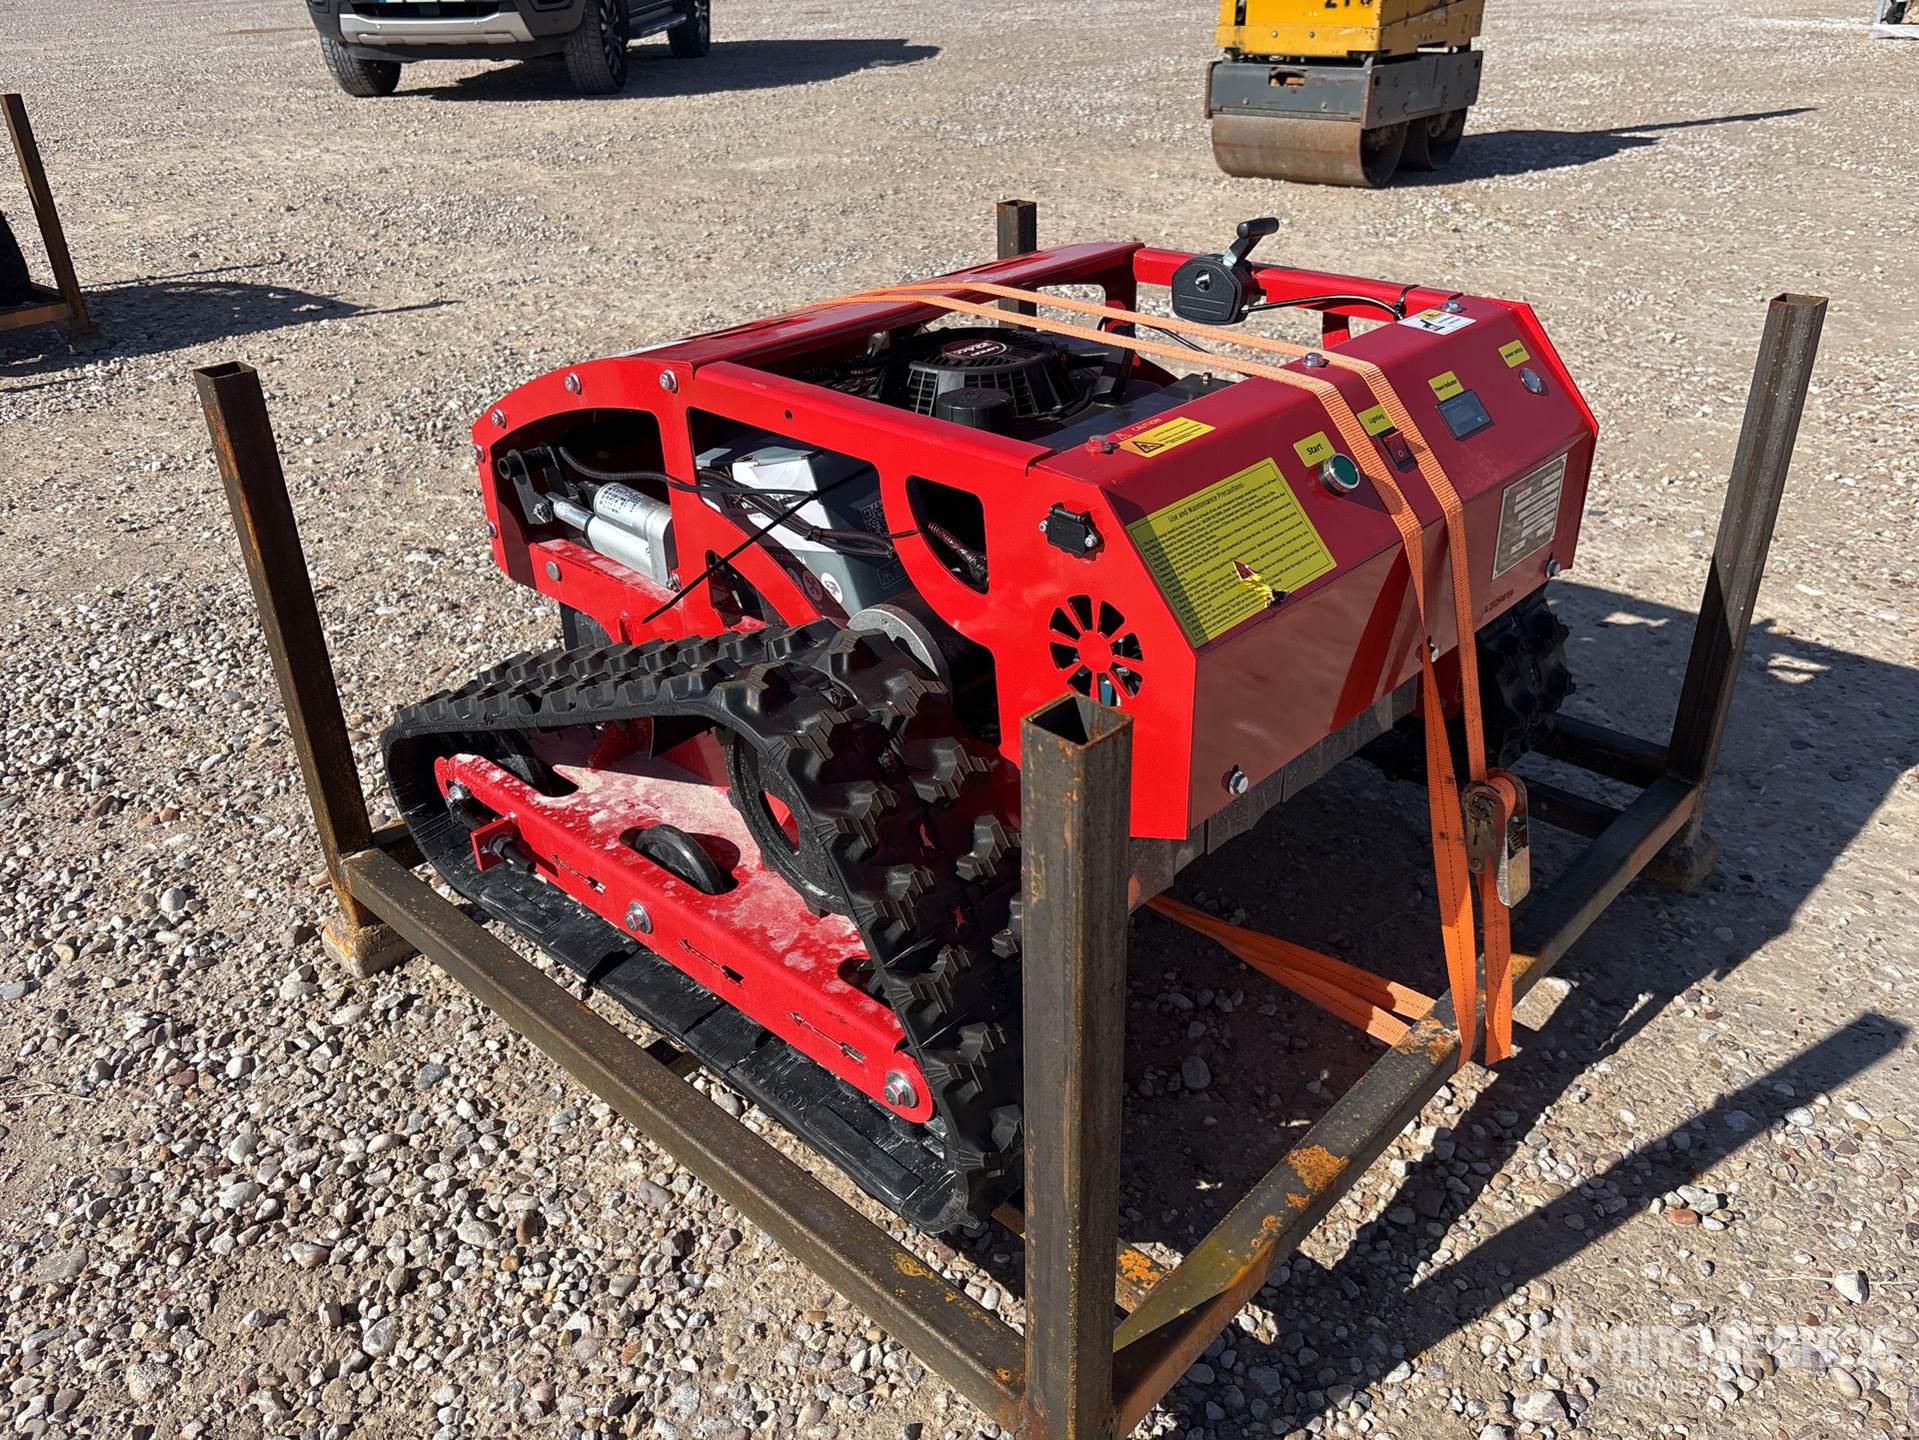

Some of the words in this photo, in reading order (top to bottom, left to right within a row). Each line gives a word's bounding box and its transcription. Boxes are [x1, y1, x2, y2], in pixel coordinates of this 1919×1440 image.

[1131, 418, 1163, 432] CAUTION
[1368, 412, 1386, 426] Lighting
[1306, 442, 1324, 456] Start
[1168, 514, 1179, 523] Use
[1178, 508, 1188, 518] and
[1186, 496, 1218, 513] Maintenance
[1216, 482, 1245, 499] Precautions
